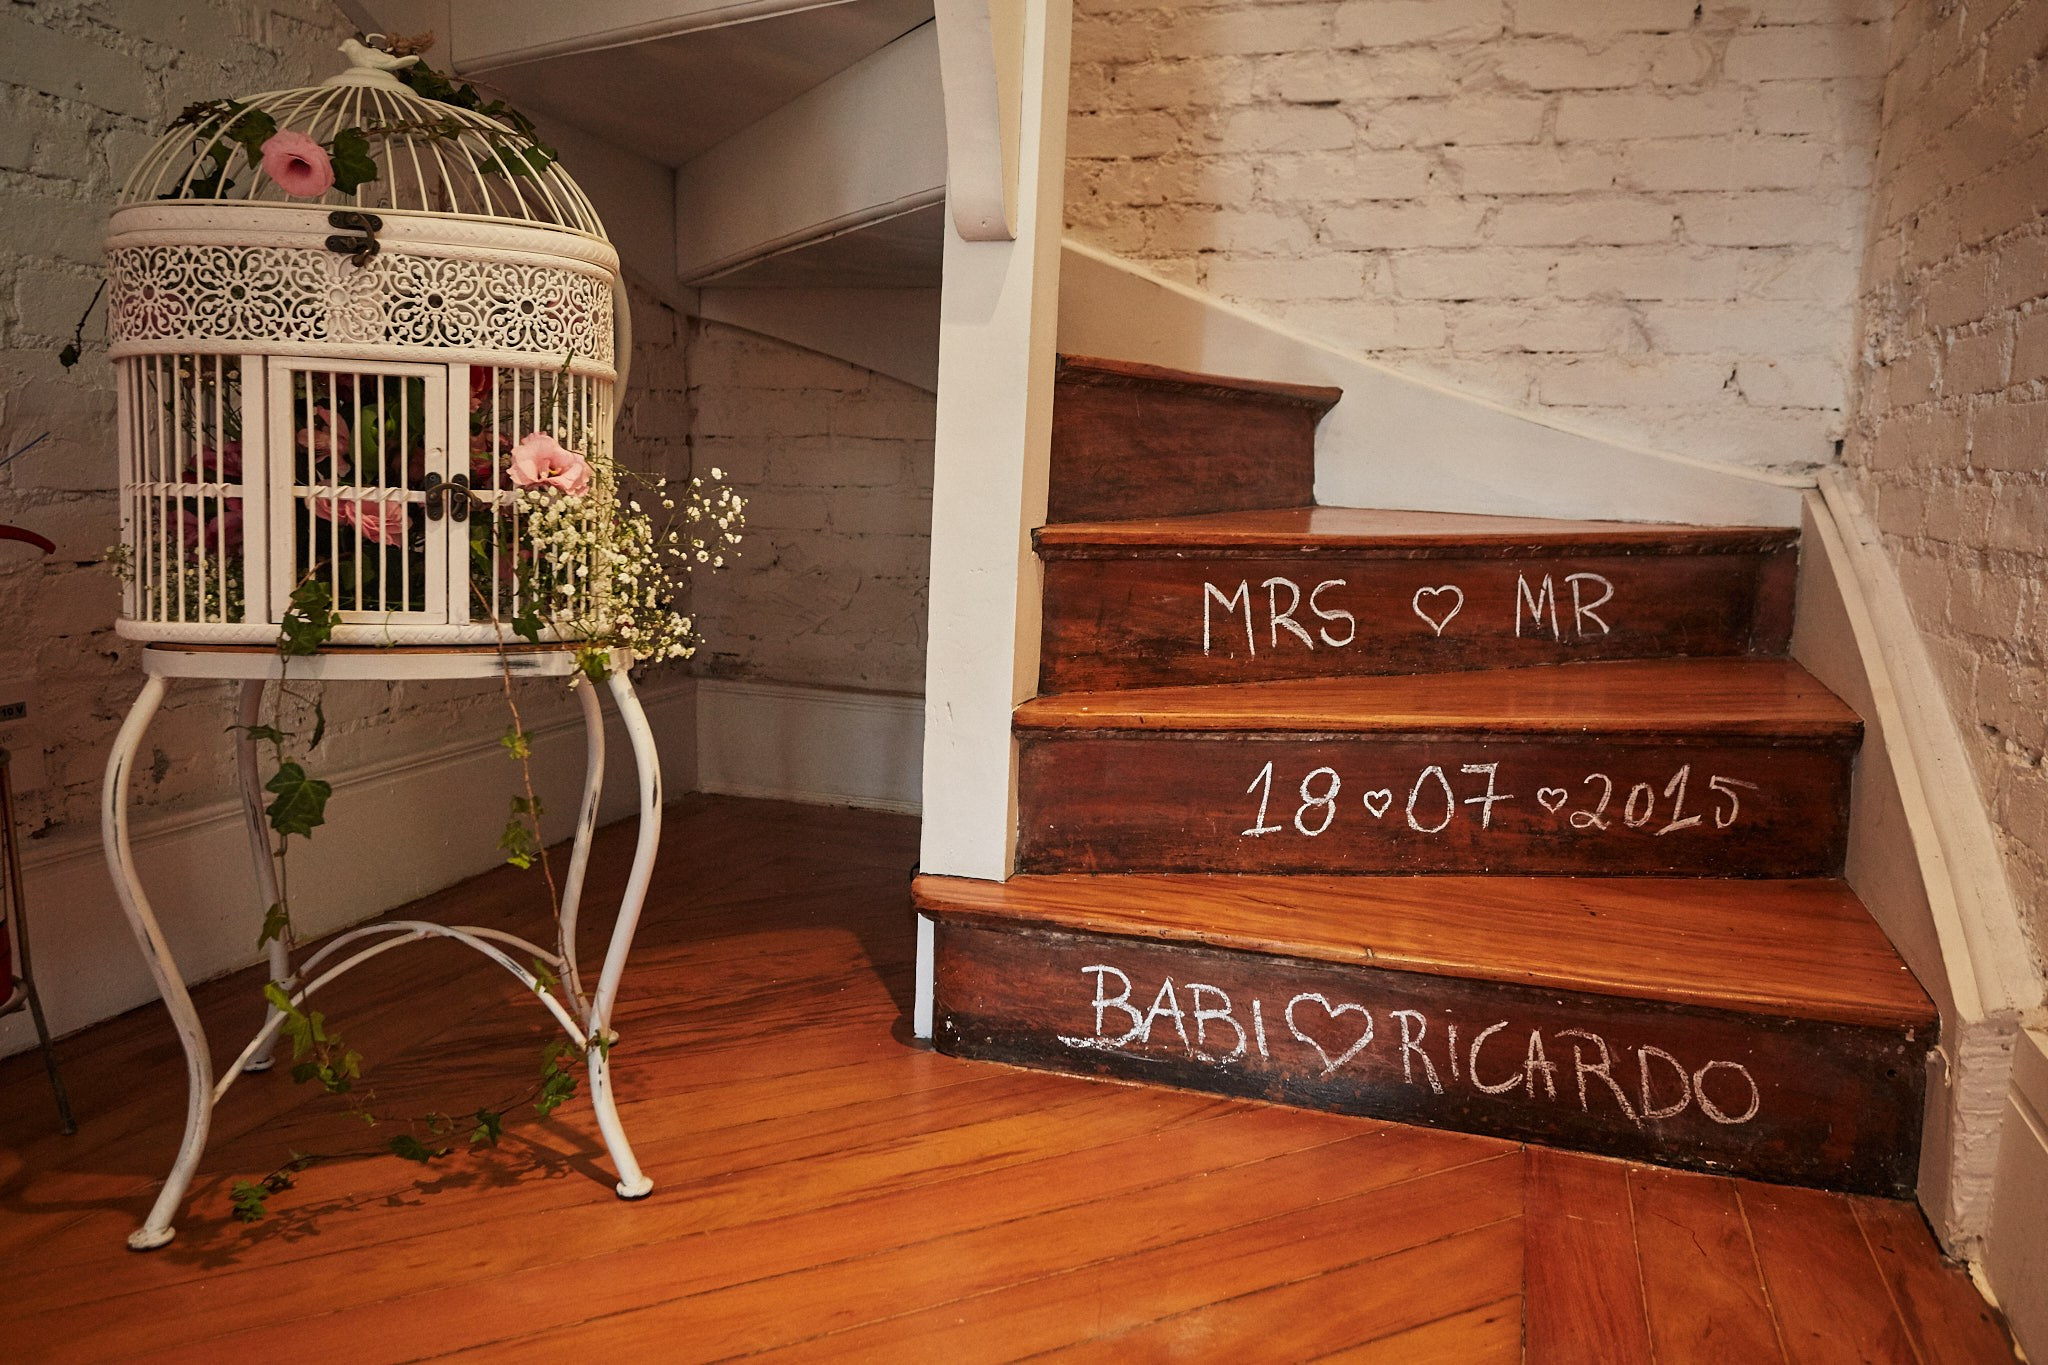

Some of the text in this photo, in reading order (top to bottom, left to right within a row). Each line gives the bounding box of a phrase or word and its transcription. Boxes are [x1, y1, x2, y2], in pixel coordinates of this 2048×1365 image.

[1202, 572, 1616, 657] MRS MR
[1242, 761, 1758, 838] 18 07 2015
[1057, 964, 1270, 1064] BABI
